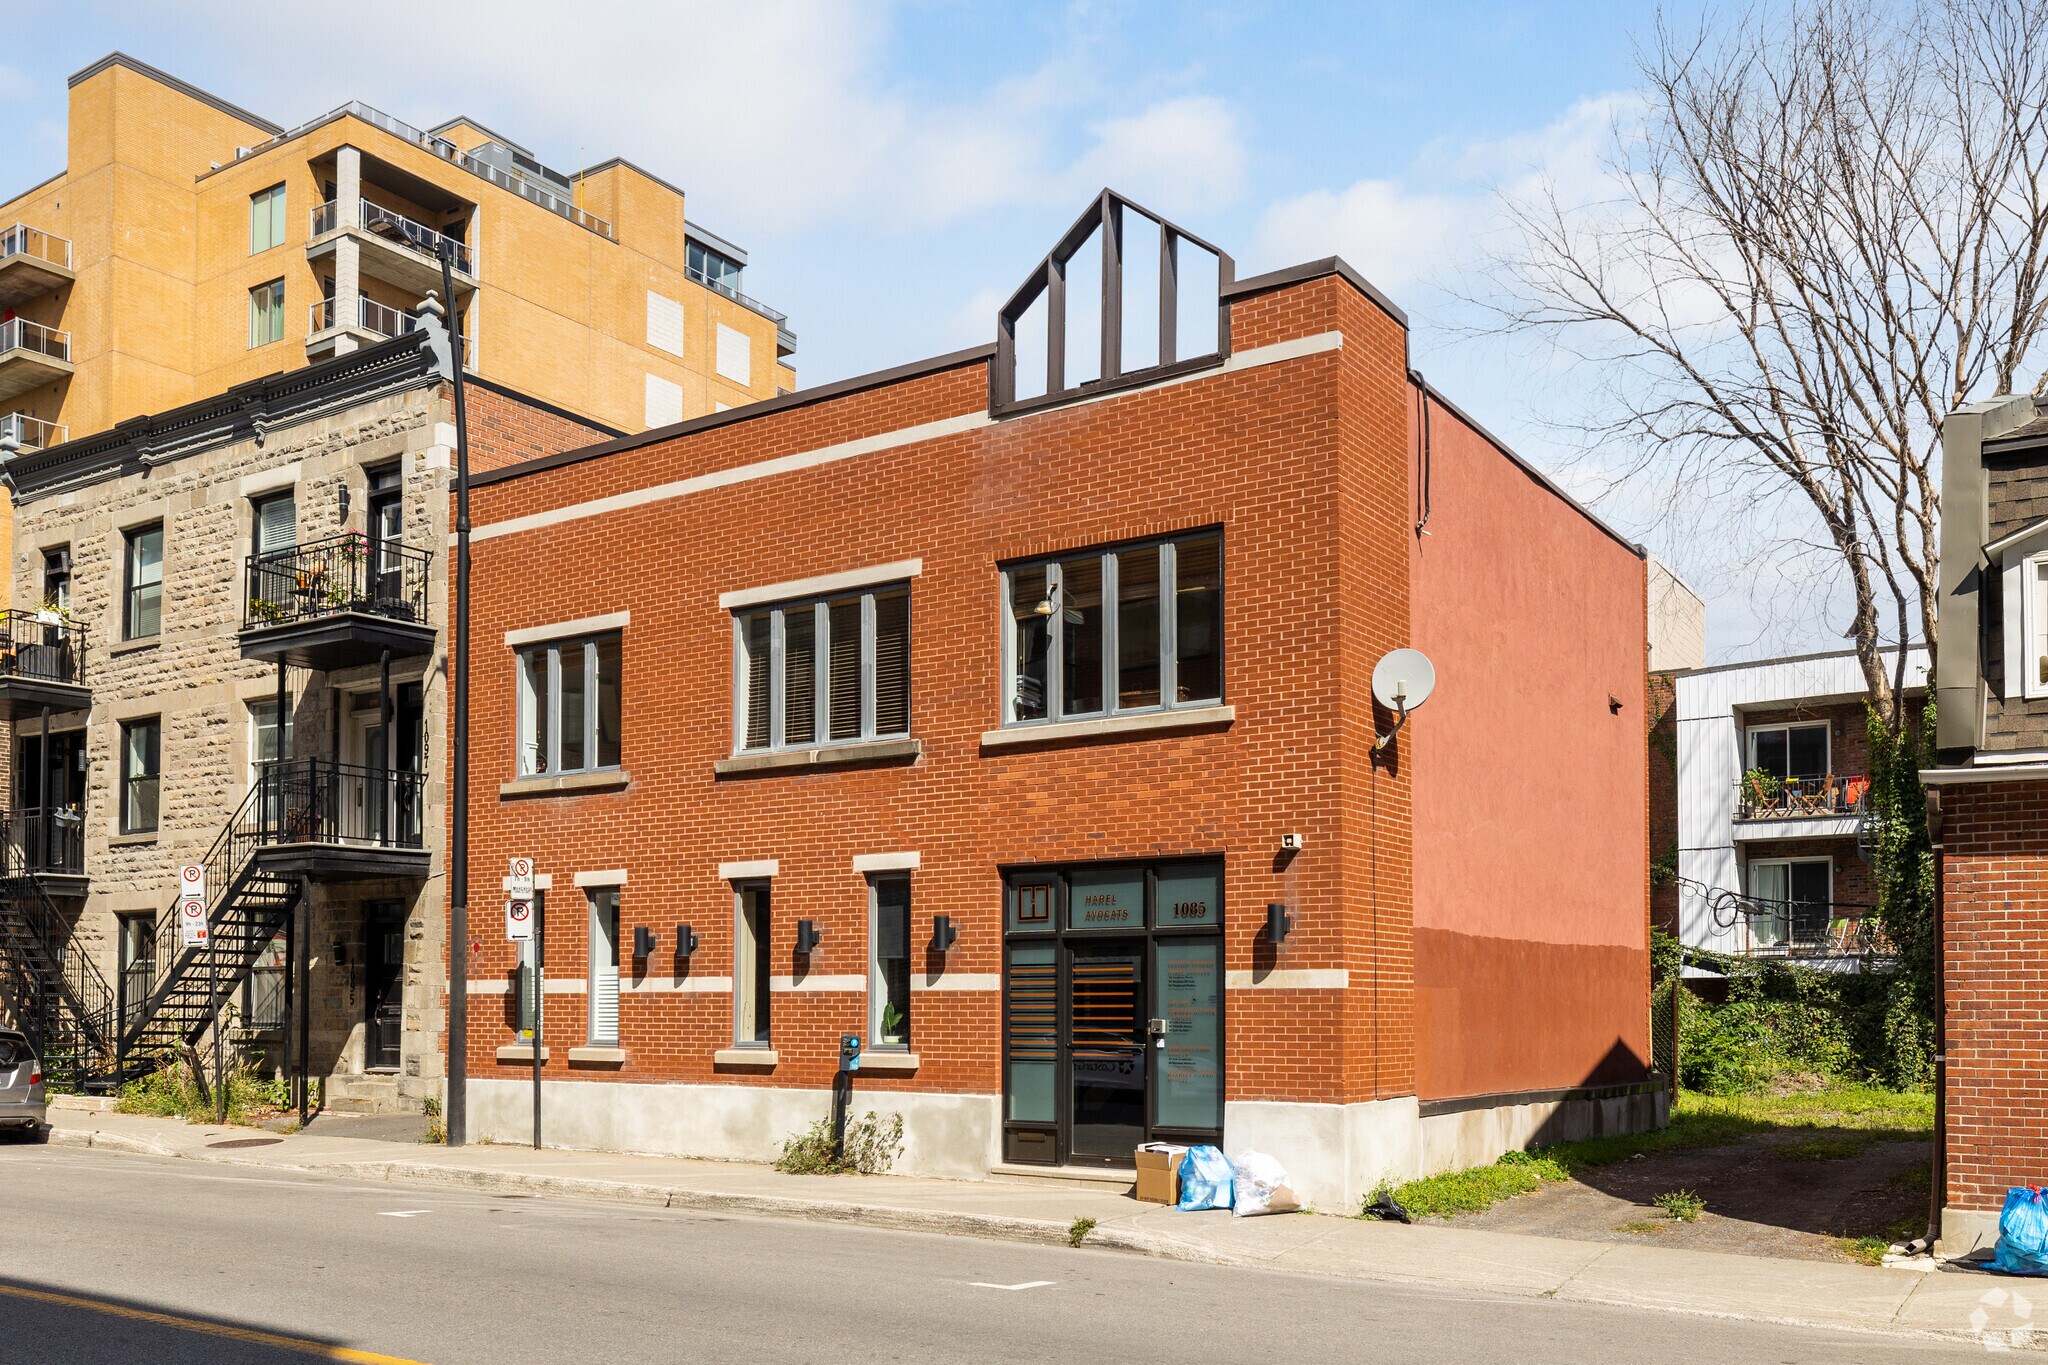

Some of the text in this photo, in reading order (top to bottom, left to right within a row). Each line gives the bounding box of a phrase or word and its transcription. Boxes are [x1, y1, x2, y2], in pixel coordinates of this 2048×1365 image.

[1085, 894, 1117, 905] HAREL
[1085, 909, 1129, 920] AVOCATS
[1173, 901, 1206, 917] 1085
